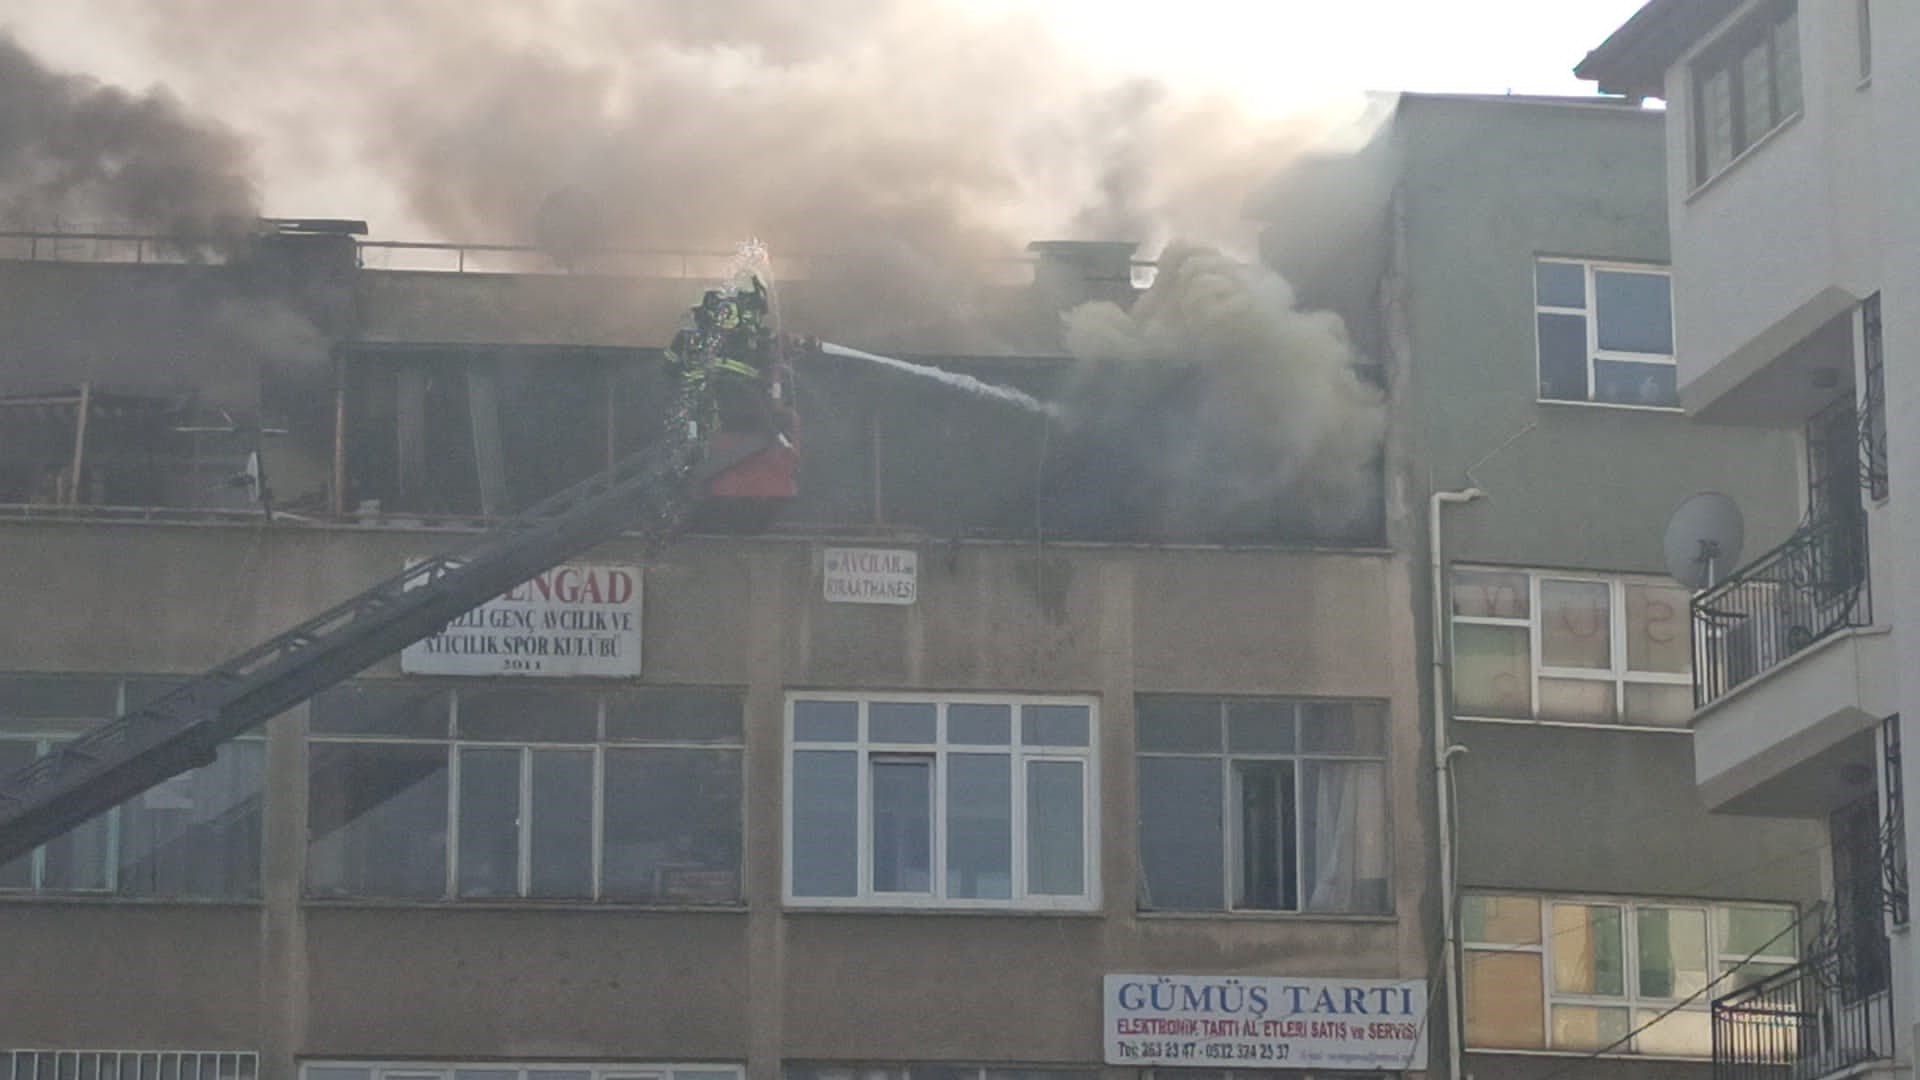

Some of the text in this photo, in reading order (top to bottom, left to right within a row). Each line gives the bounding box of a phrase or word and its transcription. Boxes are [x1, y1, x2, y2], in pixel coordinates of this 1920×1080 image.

[489, 609, 536, 633] GENÇ
[543, 610, 607, 632] AVCILIK
[613, 612, 633, 632] VE
[504, 635, 548, 656] SPOR
[503, 659, 542, 671] 2011
[1118, 976, 1413, 1020] GÜMÜŞ TARTI
[1352, 1025, 1365, 1040] ve
